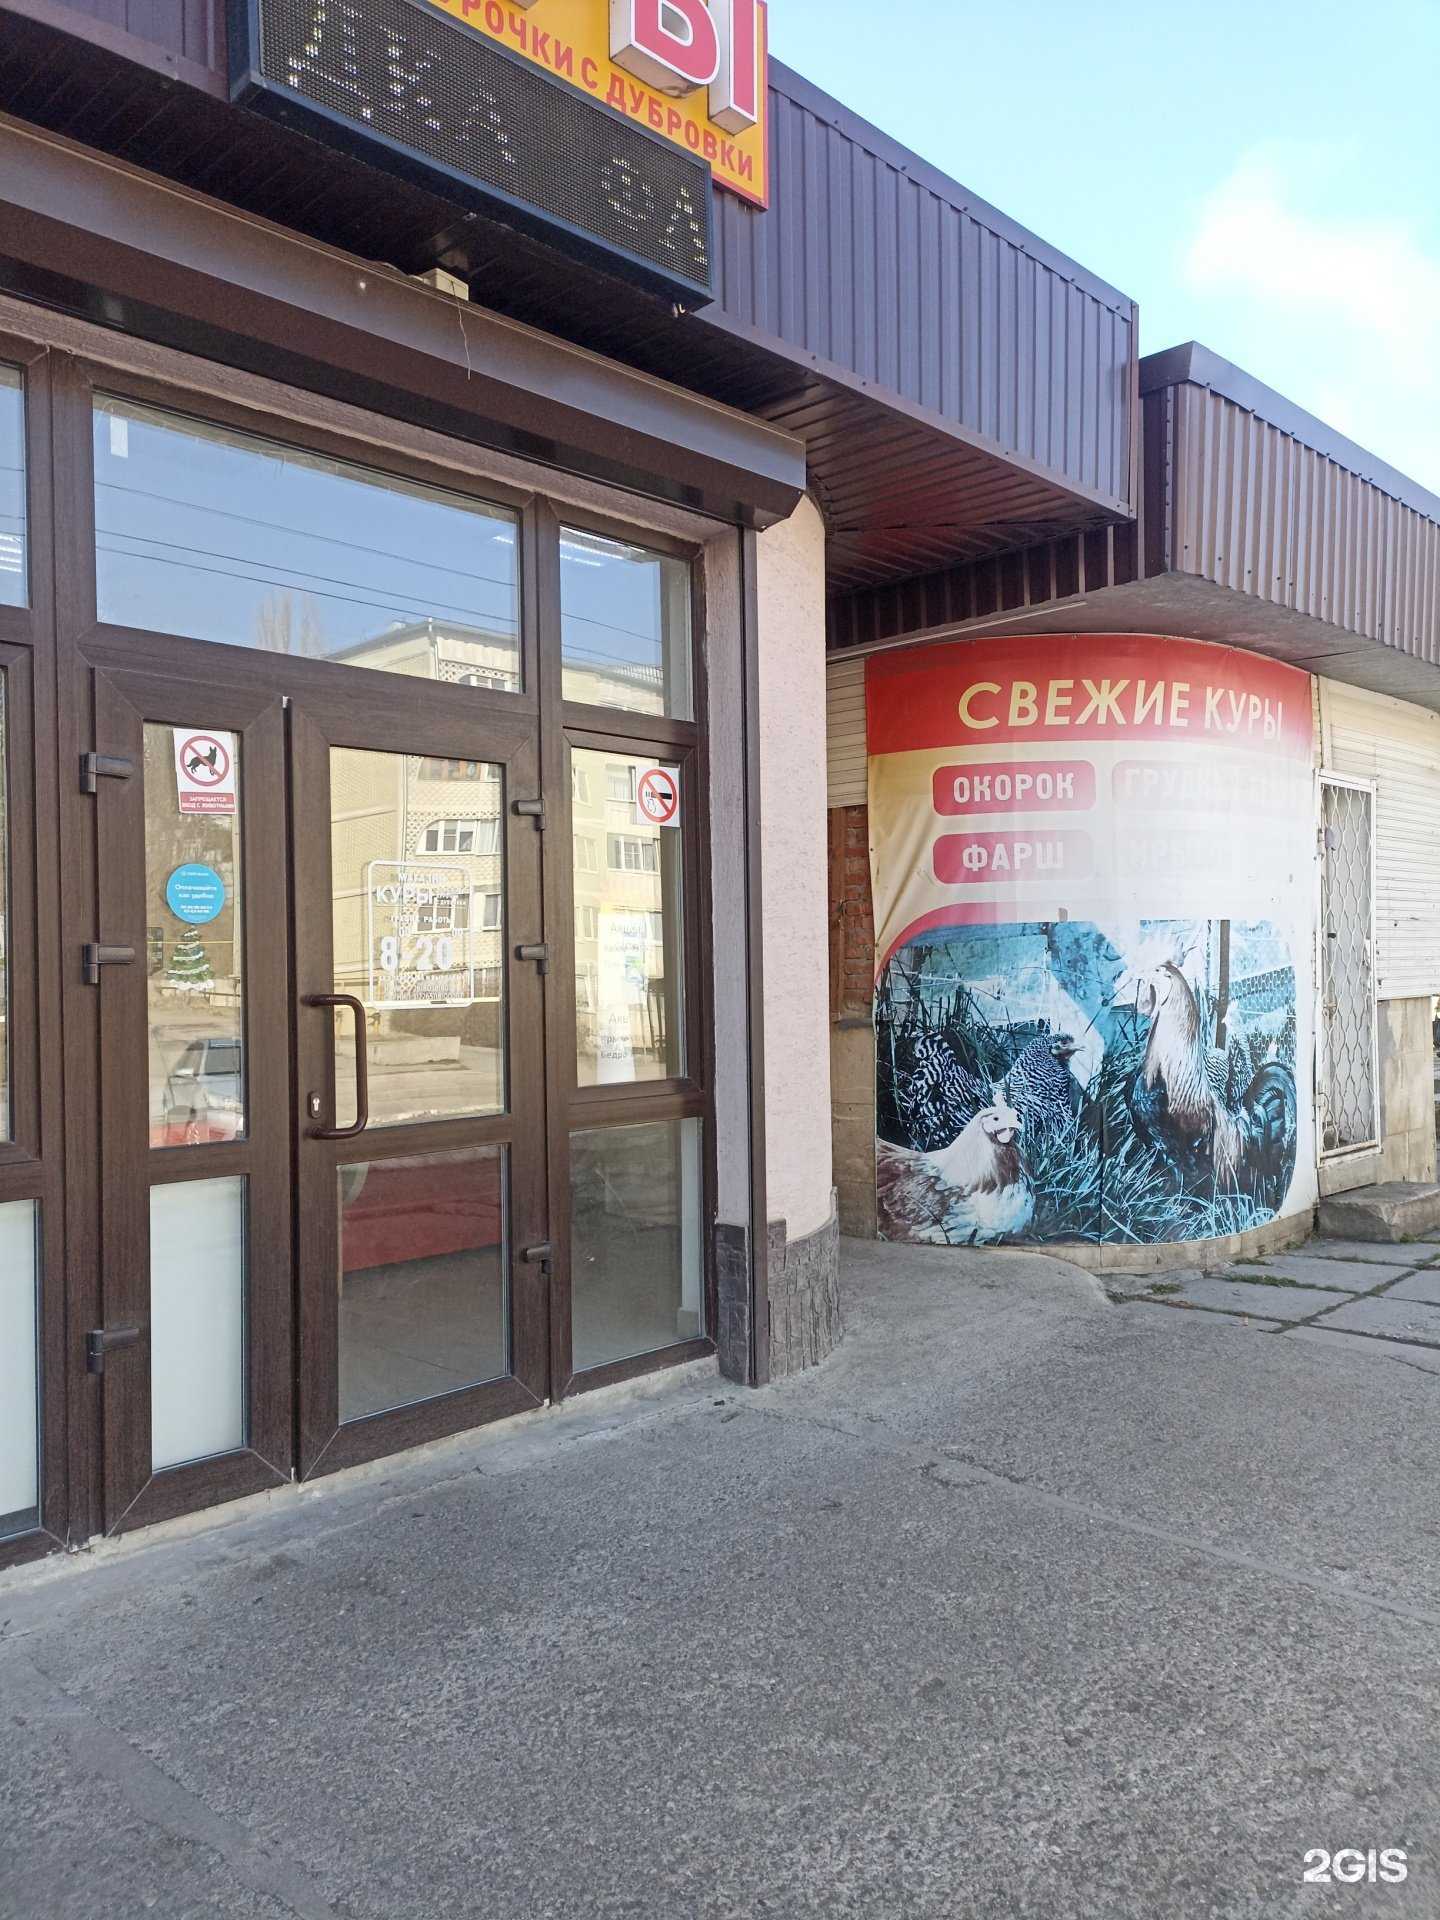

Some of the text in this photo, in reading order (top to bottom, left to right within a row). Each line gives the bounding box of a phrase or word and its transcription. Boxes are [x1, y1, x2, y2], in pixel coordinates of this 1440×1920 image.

[442, 0, 753, 182] РОЧКИ С ДУБРОВКИ
[958, 679, 1284, 741] СВЕЖИЕ КУРЫ
[953, 772, 1075, 803] ОКОРОК
[962, 841, 1065, 871] ФАРШ
